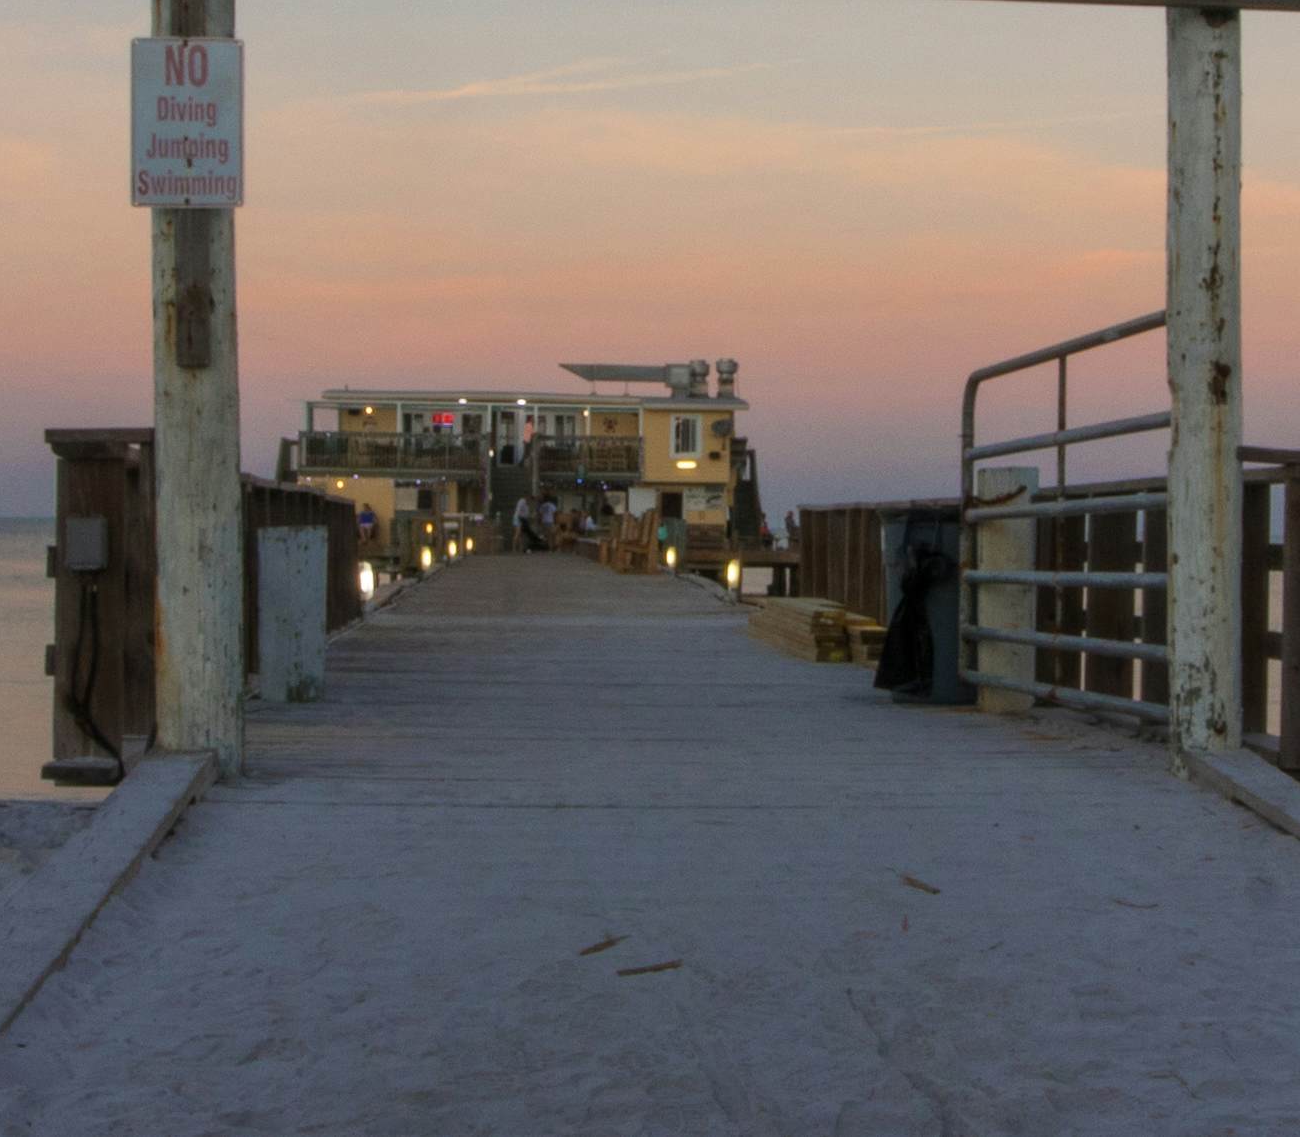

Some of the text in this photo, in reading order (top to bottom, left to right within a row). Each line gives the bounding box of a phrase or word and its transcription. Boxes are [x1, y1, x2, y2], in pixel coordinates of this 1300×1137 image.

[164, 44, 209, 87] NO
[156, 96, 217, 127] Diving
[146, 133, 229, 163] Jumping
[138, 169, 237, 200] Swimming
